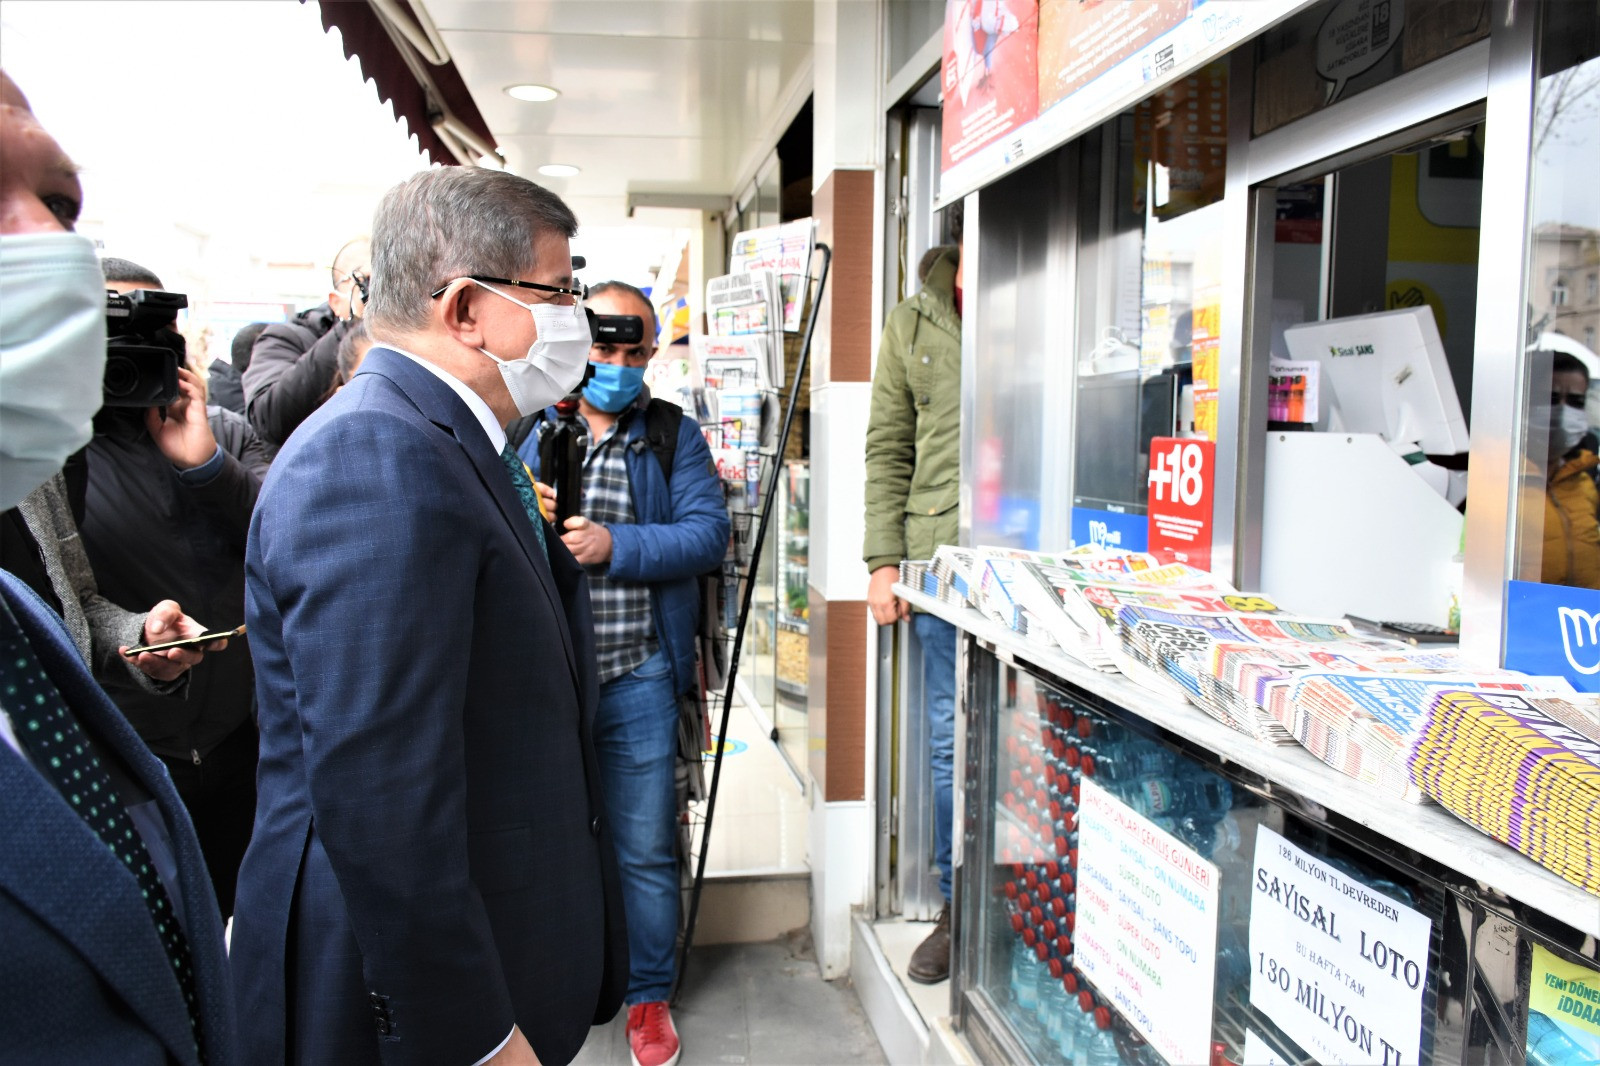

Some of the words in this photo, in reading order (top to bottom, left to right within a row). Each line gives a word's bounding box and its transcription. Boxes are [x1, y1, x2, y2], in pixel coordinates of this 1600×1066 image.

[1373, 2, 1389, 27] 18
[1148, 443, 1203, 506] +18
[1171, 847, 1210, 888] GÜNLERİ
[1141, 884, 1162, 907] LOTO
[1154, 865, 1167, 884] ON
[1168, 873, 1206, 913] NUMARA
[1342, 883, 1399, 923] DEVREDEN
[1141, 935, 1162, 960] LOTO
[1175, 935, 1198, 963] TOPU
[1256, 867, 1342, 943] SAYISAL
[1359, 930, 1422, 991] LOTO
[1116, 938, 1128, 957] ON
[1129, 947, 1163, 990] NUMARA
[1295, 941, 1308, 958] BU
[1309, 948, 1342, 983] HAFTA
[1344, 972, 1366, 999] TAM
[1545, 972, 1568, 992] YENİ
[1133, 1005, 1153, 1033] TOPU
[1258, 951, 1291, 994] 130
[1294, 976, 1374, 1058] MİLYON
